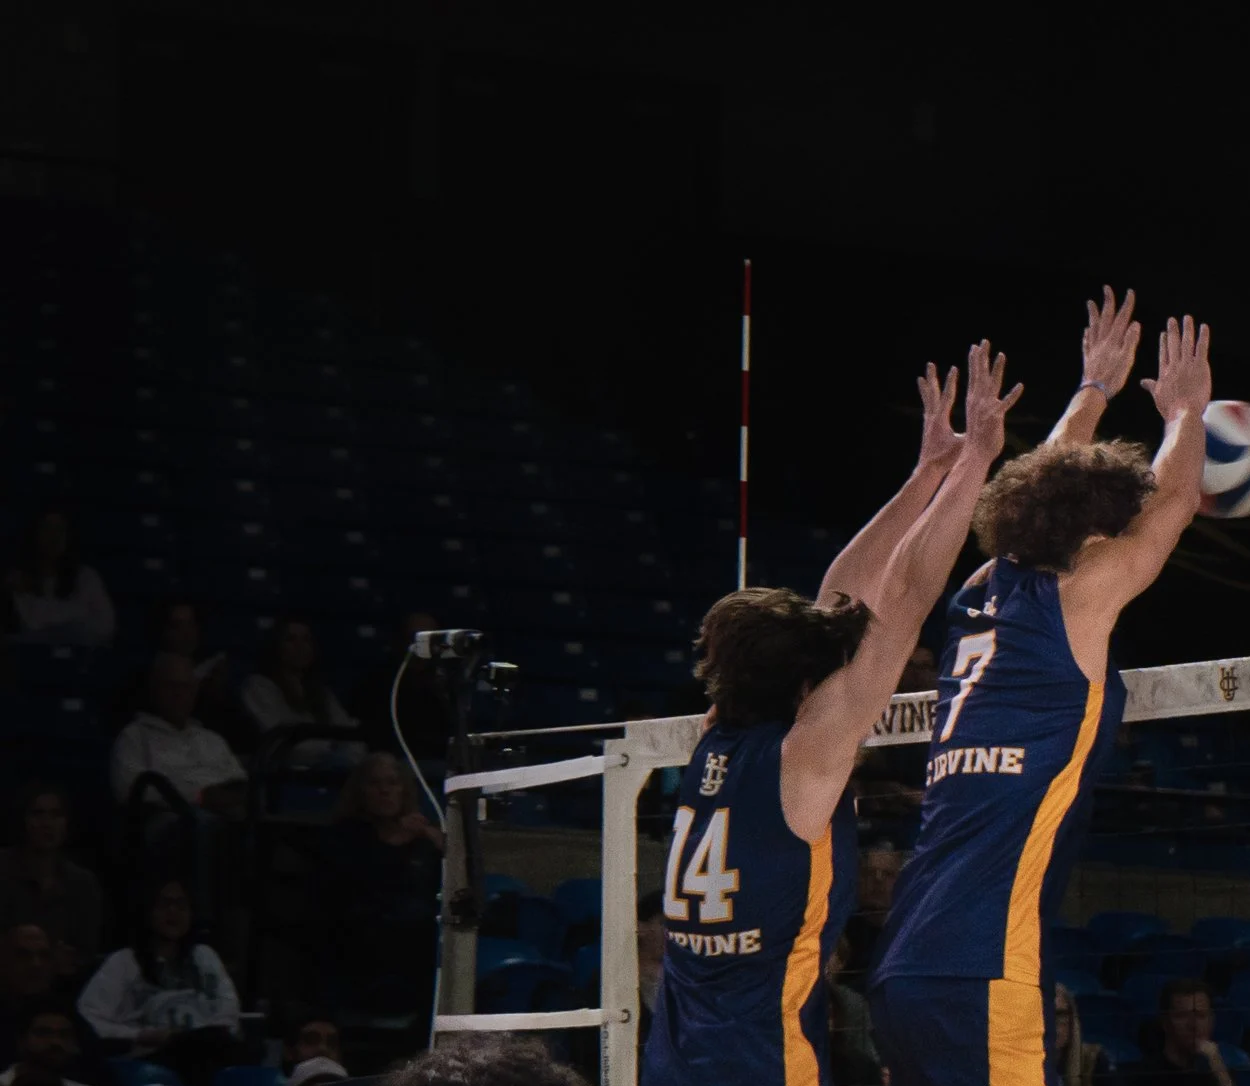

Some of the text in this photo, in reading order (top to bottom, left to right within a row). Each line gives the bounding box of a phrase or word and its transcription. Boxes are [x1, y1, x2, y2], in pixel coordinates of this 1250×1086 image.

[873, 700, 937, 736] VINE
[940, 628, 997, 743] 7
[663, 805, 739, 923] 14
